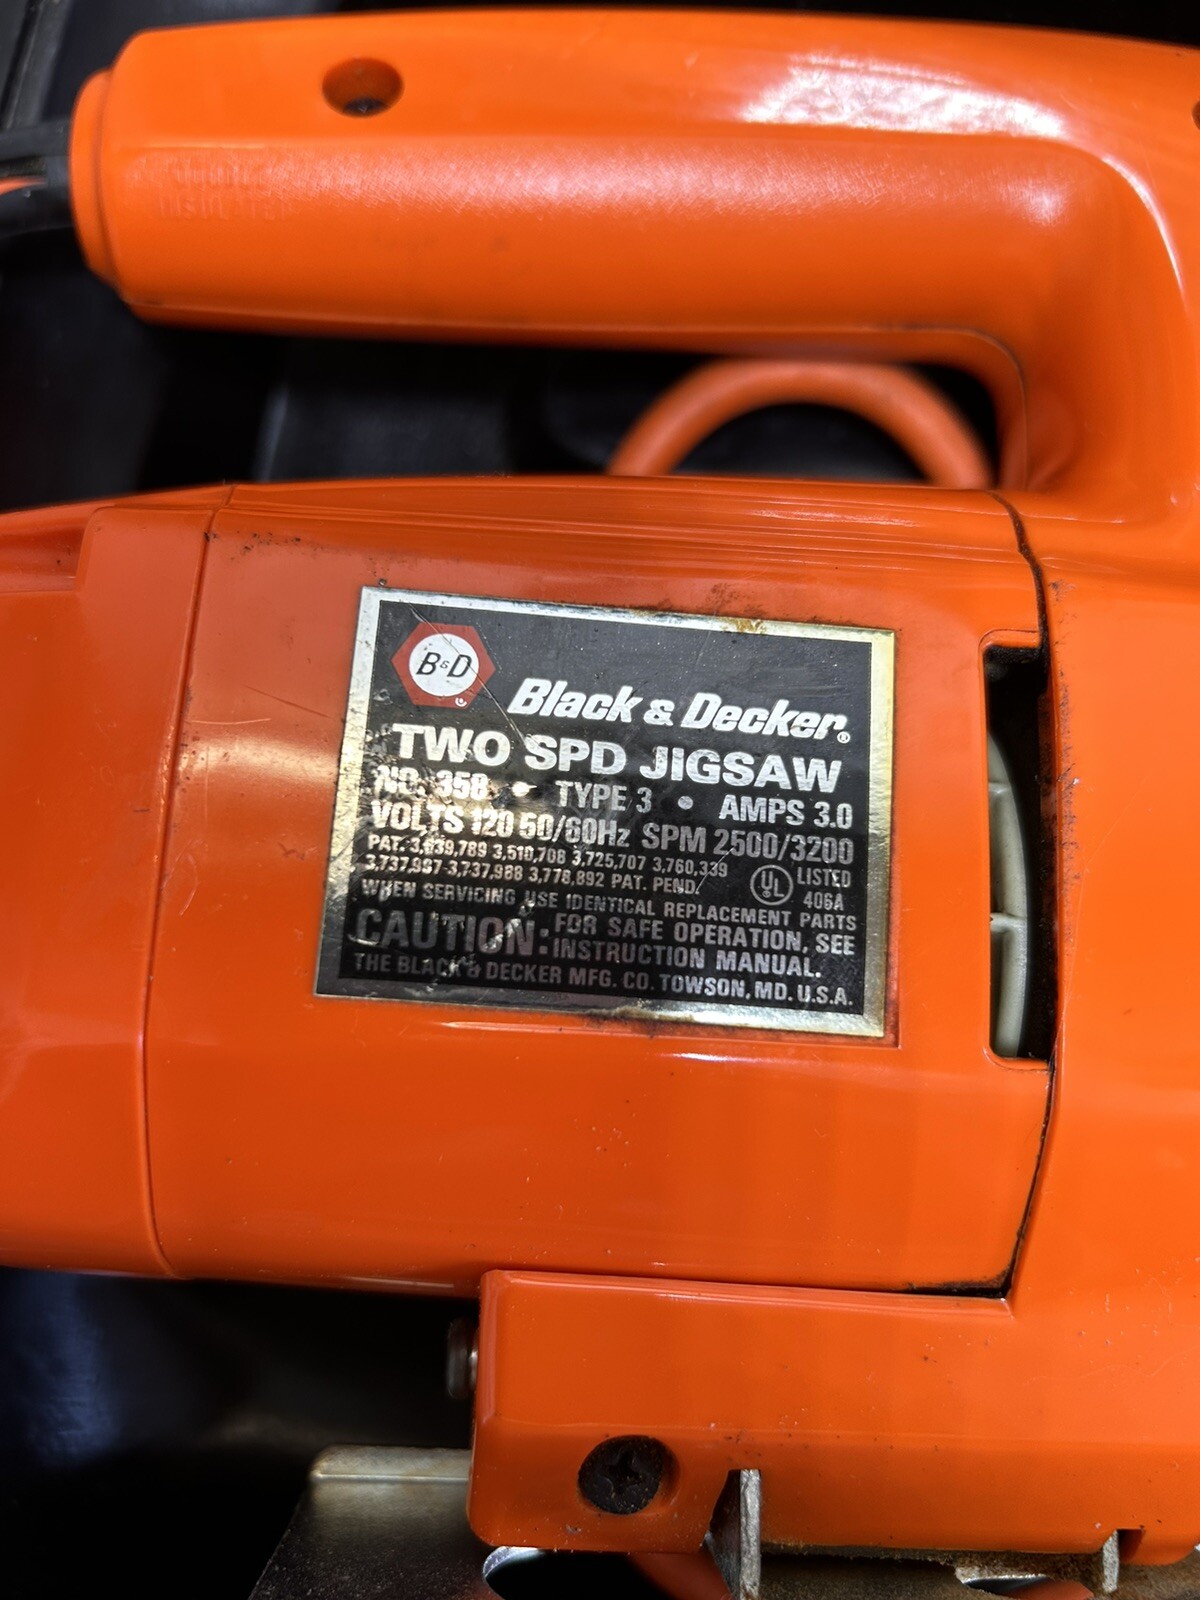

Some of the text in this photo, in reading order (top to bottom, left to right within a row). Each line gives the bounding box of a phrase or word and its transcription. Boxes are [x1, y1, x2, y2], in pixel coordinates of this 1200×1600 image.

[507, 677, 643, 723] Black
[643, 699, 675, 727] &
[392, 723, 843, 794] TWO SPD JIGSAW
[555, 780, 628, 812] TYPE
[635, 786, 653, 814] 3
[719, 794, 805, 826] AMPS
[813, 801, 853, 829] 3.0
[371, 800, 854, 866] VOLTS 120 50/60Hz SPM 2500/3200
[528, 866, 605, 888] 3,778,892
[610, 873, 647, 892] PAT.
[571, 848, 647, 872] 3,725,707
[652, 857, 728, 878] 3,760,339
[797, 866, 851, 888] LISTED
[361, 878, 857, 931] WHEN SERVICING USE IDENTICAL REPLACEMENT PARTS
[803, 891, 845, 912] 406A
[554, 912, 598, 936] FOR
[607, 916, 664, 941] SAFE
[815, 933, 856, 956] SEE
[354, 952, 391, 973] THE
[396, 955, 463, 980] BLACK
[485, 961, 562, 985] DECKER
[568, 968, 618, 989] MFG.
[622, 970, 655, 992] CO.
[754, 980, 793, 1002] MD.
[797, 984, 854, 1007] U.S.A.
[552, 937, 822, 979] INSTRUCTION MANUAL.
